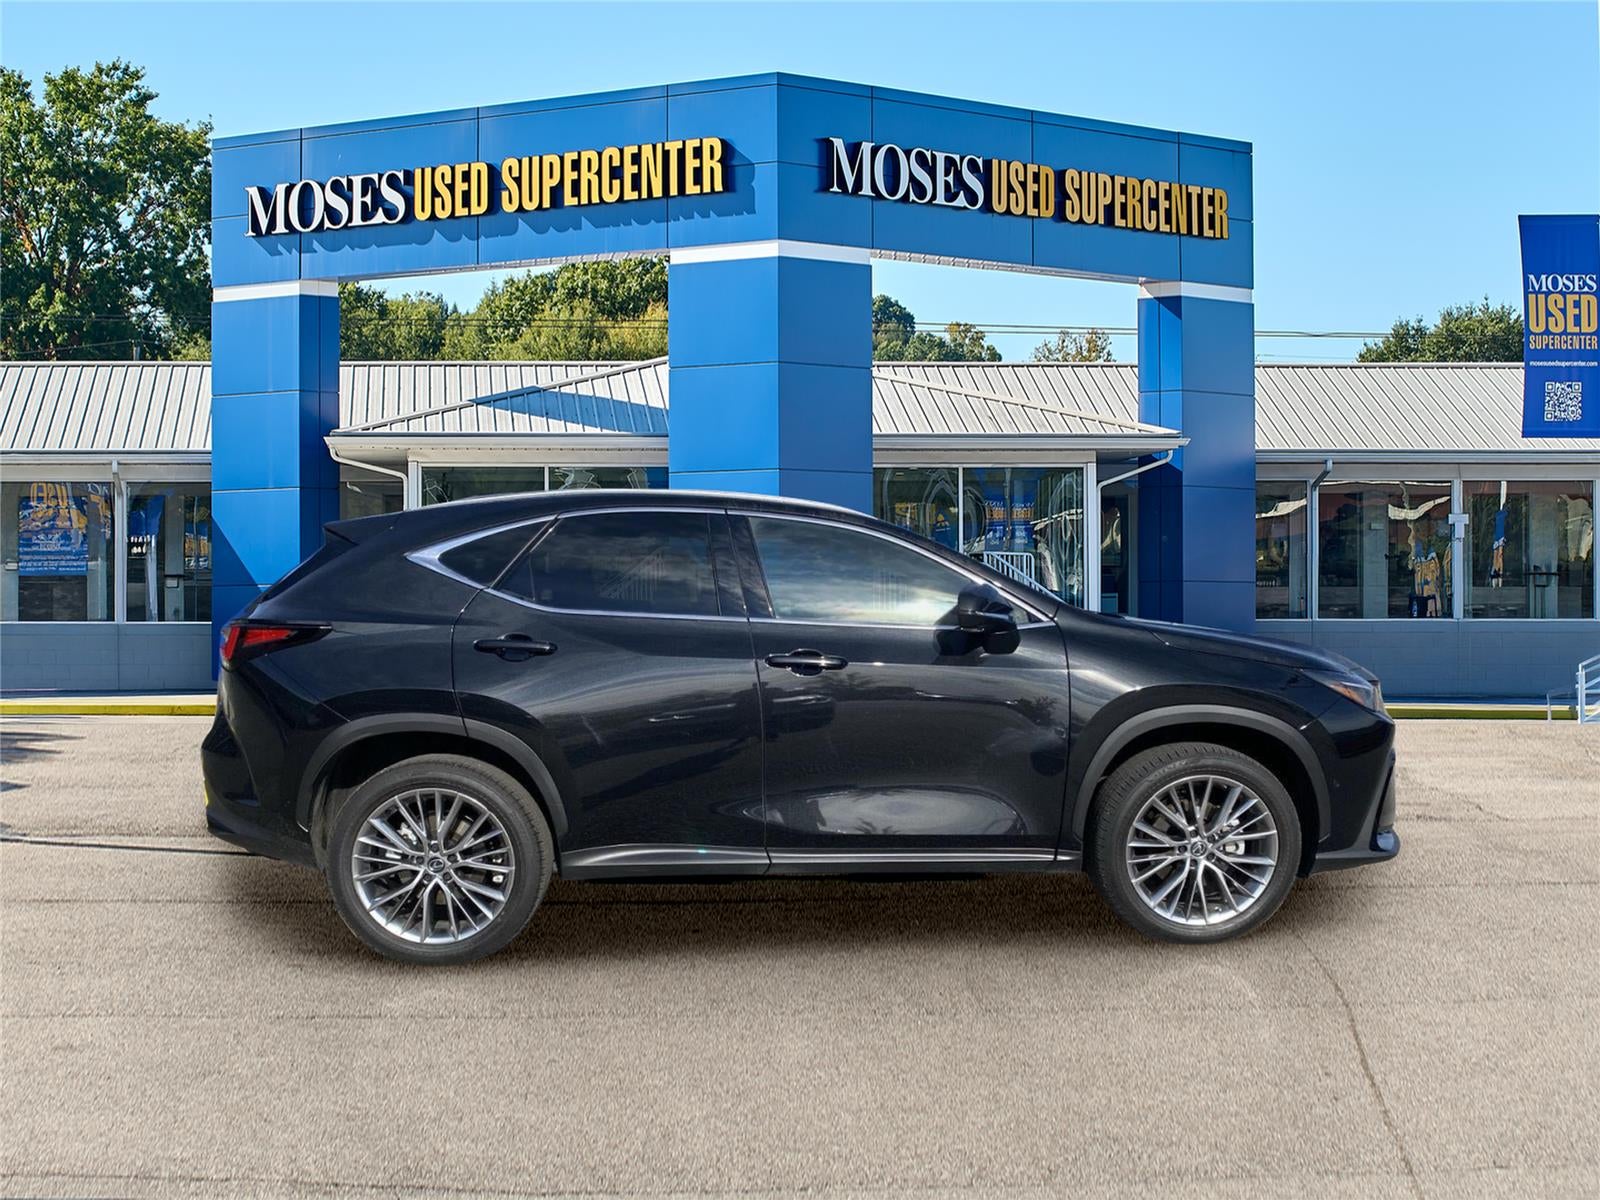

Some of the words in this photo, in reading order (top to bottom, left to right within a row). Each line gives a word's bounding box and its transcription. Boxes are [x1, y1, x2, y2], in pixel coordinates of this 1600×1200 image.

[244, 169, 407, 237] MOSES
[413, 161, 489, 221] USED
[501, 136, 724, 213] SUPERCENTER
[828, 136, 985, 210] MOSES
[991, 158, 1055, 218] USED
[1065, 168, 1230, 240] SUPERCENTER
[1527, 274, 1597, 292] MOSES
[1527, 294, 1598, 333] USED
[1529, 335, 1598, 350] SUPERCENTER
